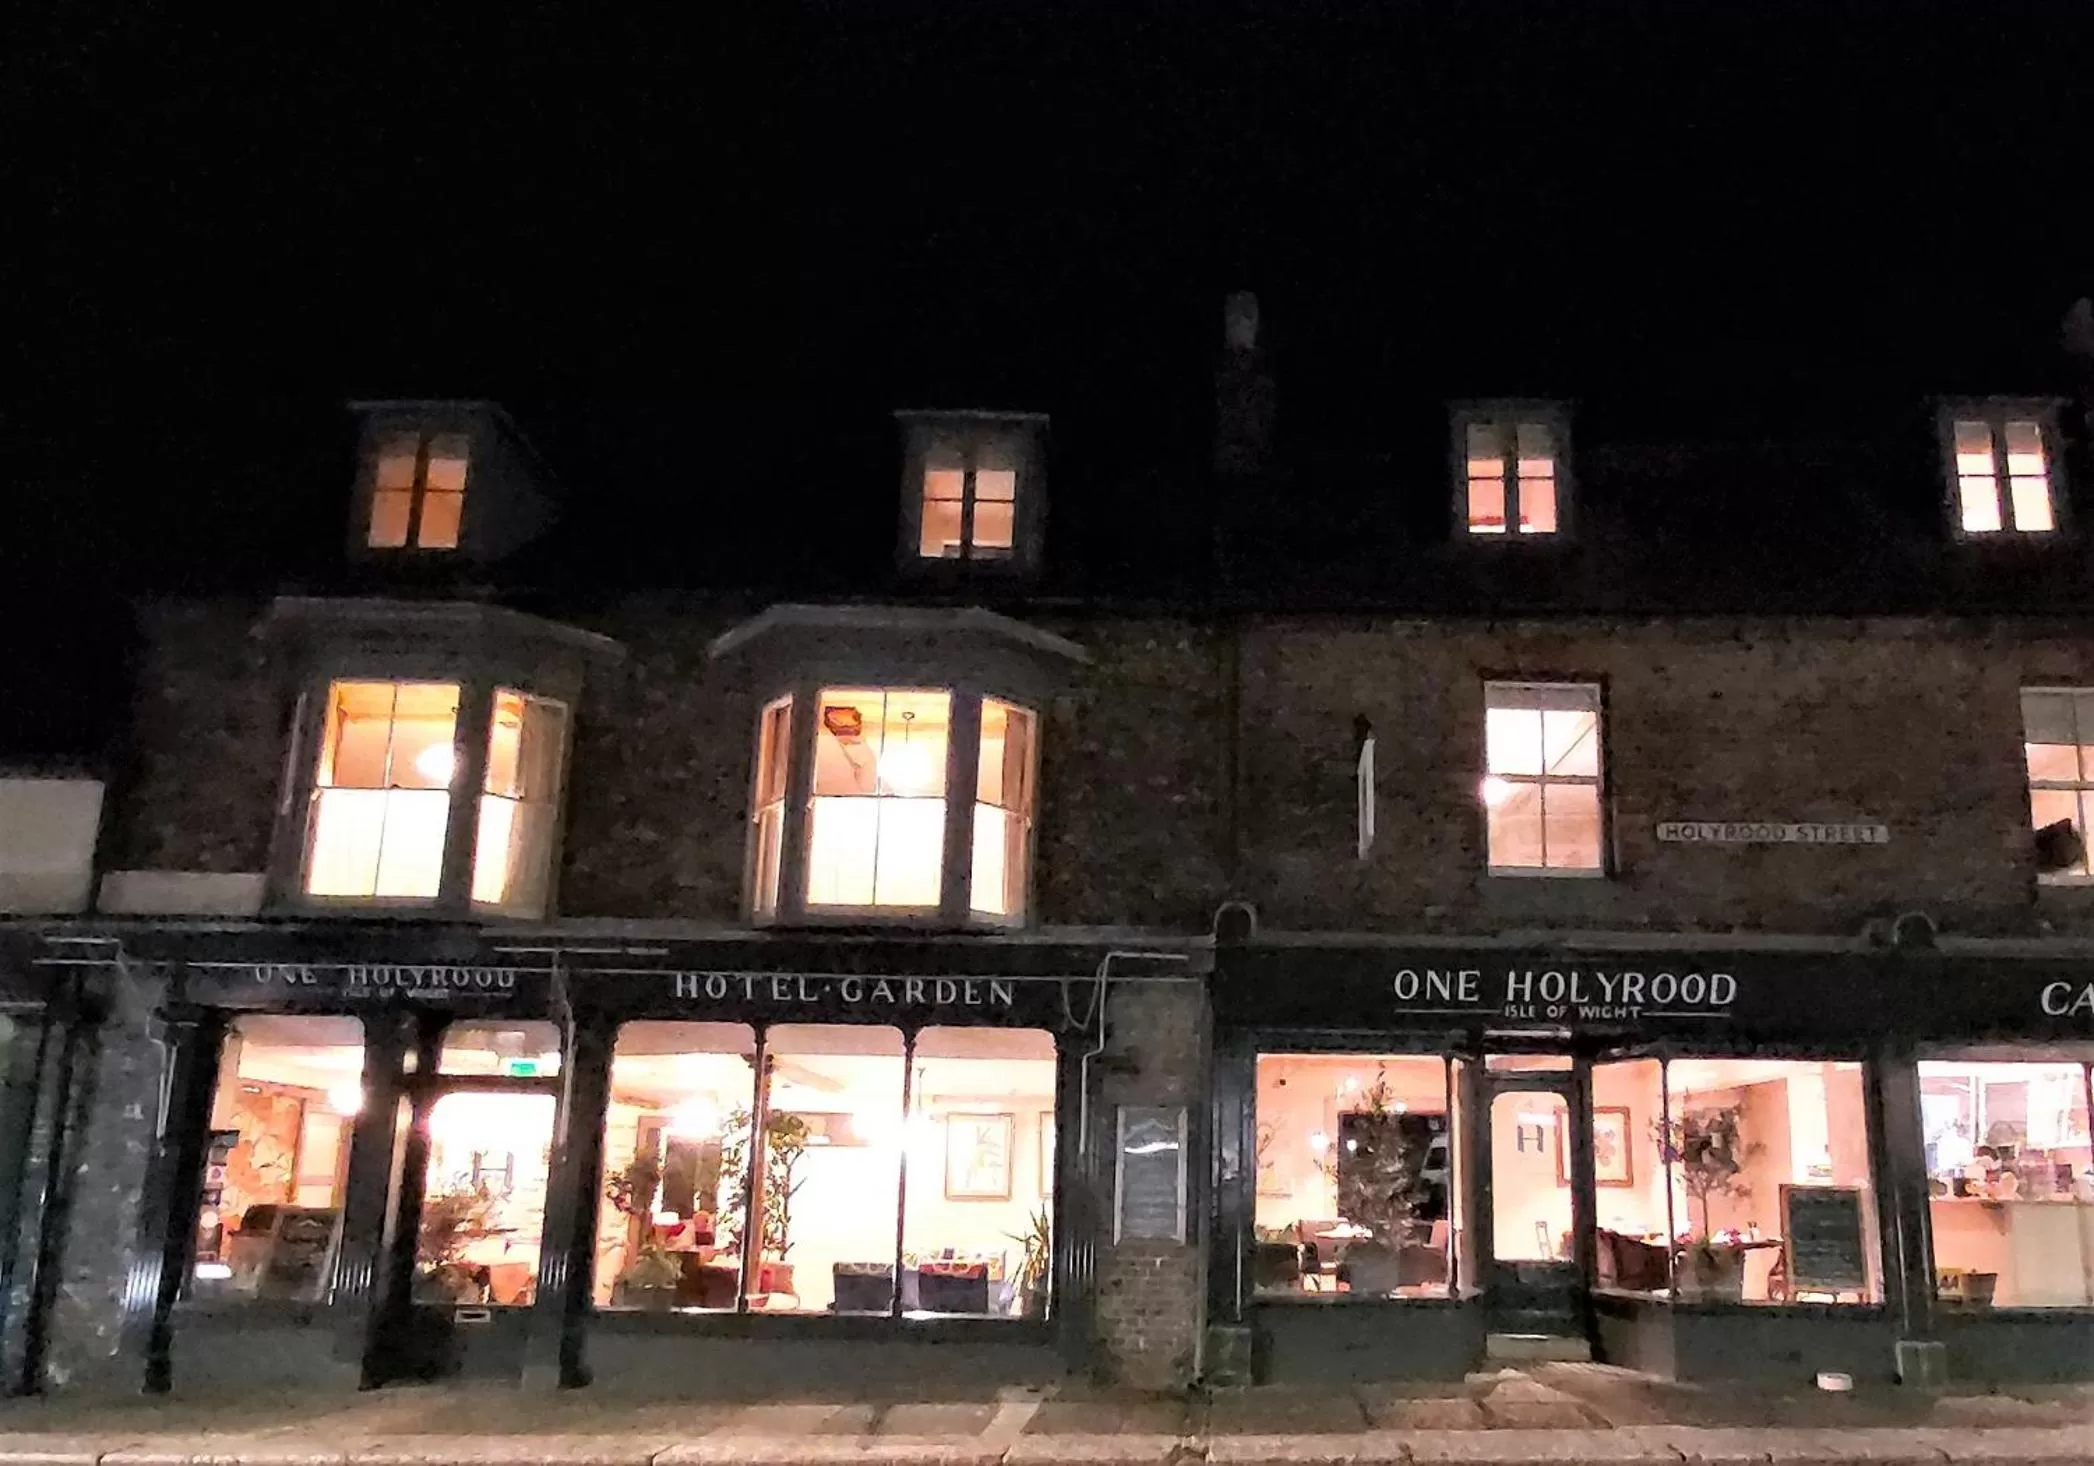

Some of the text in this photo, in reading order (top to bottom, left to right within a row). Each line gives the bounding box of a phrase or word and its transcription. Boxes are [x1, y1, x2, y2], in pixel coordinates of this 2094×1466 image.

[1666, 823, 1879, 842] HOLYROOD STREET
[840, 974, 1013, 1006] GARDEN
[1393, 969, 1737, 1005] ONE HOLYROOD
[1504, 1005, 1643, 1020] ISLE OF WIGHT
